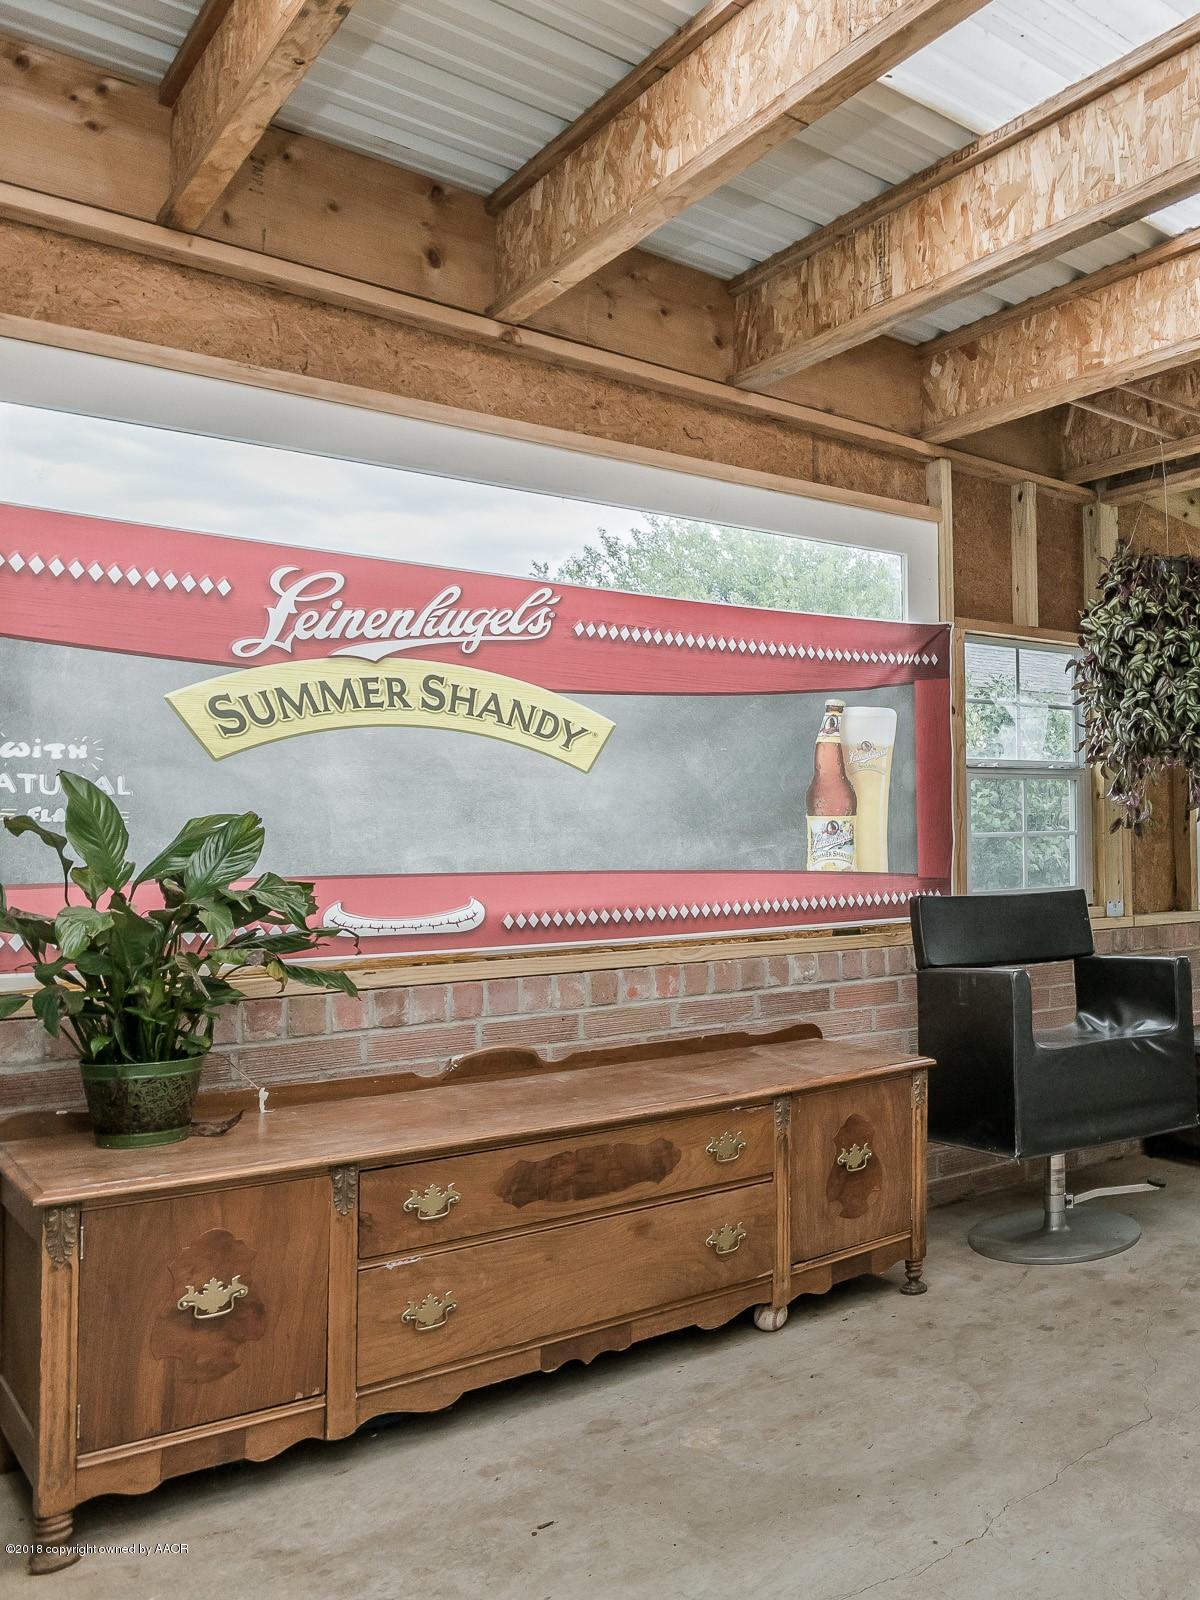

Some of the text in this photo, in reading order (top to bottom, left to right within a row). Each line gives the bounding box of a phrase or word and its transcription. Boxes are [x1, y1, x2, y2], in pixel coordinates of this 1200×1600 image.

[231, 565, 563, 662] Leinenkugel's
[206, 673, 589, 752] SUMMER SHANDY
